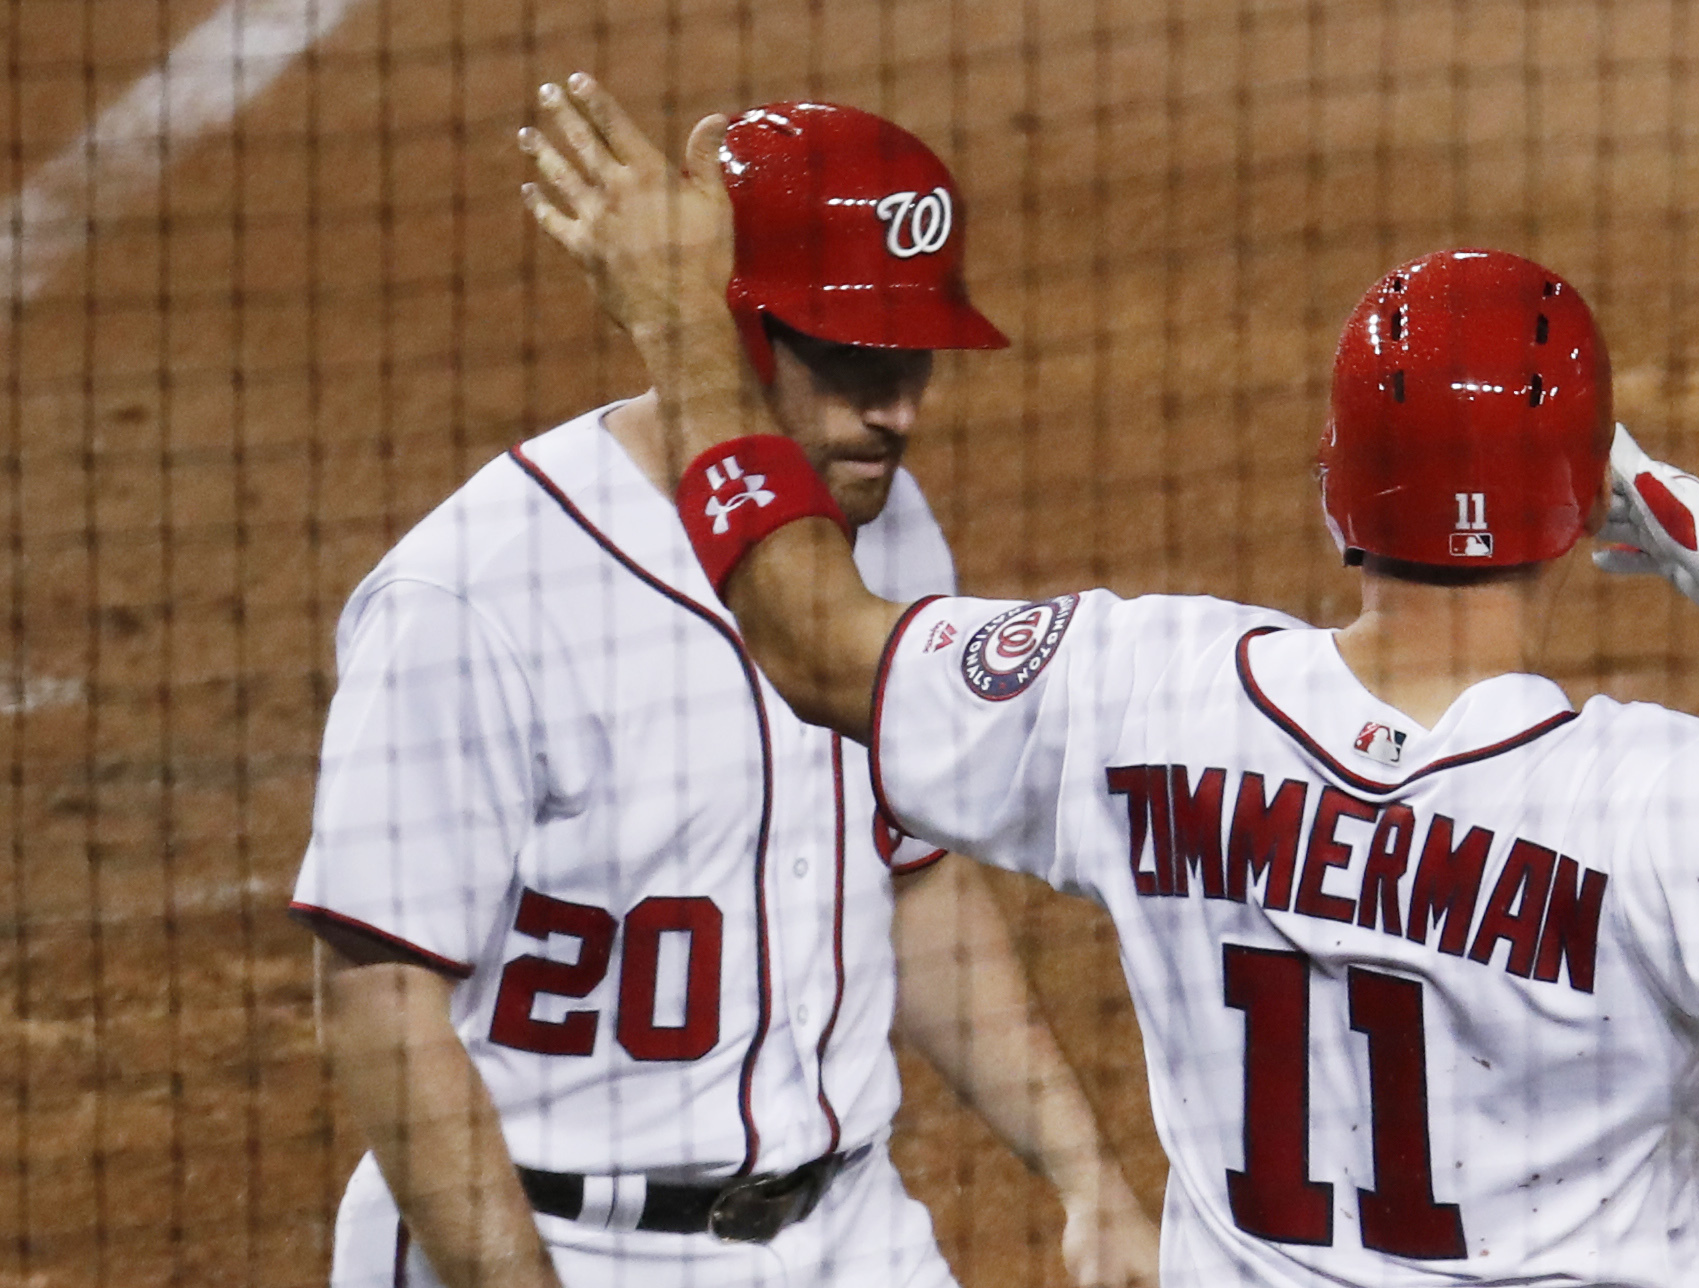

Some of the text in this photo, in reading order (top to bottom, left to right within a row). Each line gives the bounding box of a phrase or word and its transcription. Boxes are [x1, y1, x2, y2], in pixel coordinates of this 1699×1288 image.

[1454, 493, 1488, 530] 11
[488, 886, 724, 1061] 20
[1105, 764, 1609, 994] ZIMMERMAN
[1222, 942, 1468, 1260] 11
